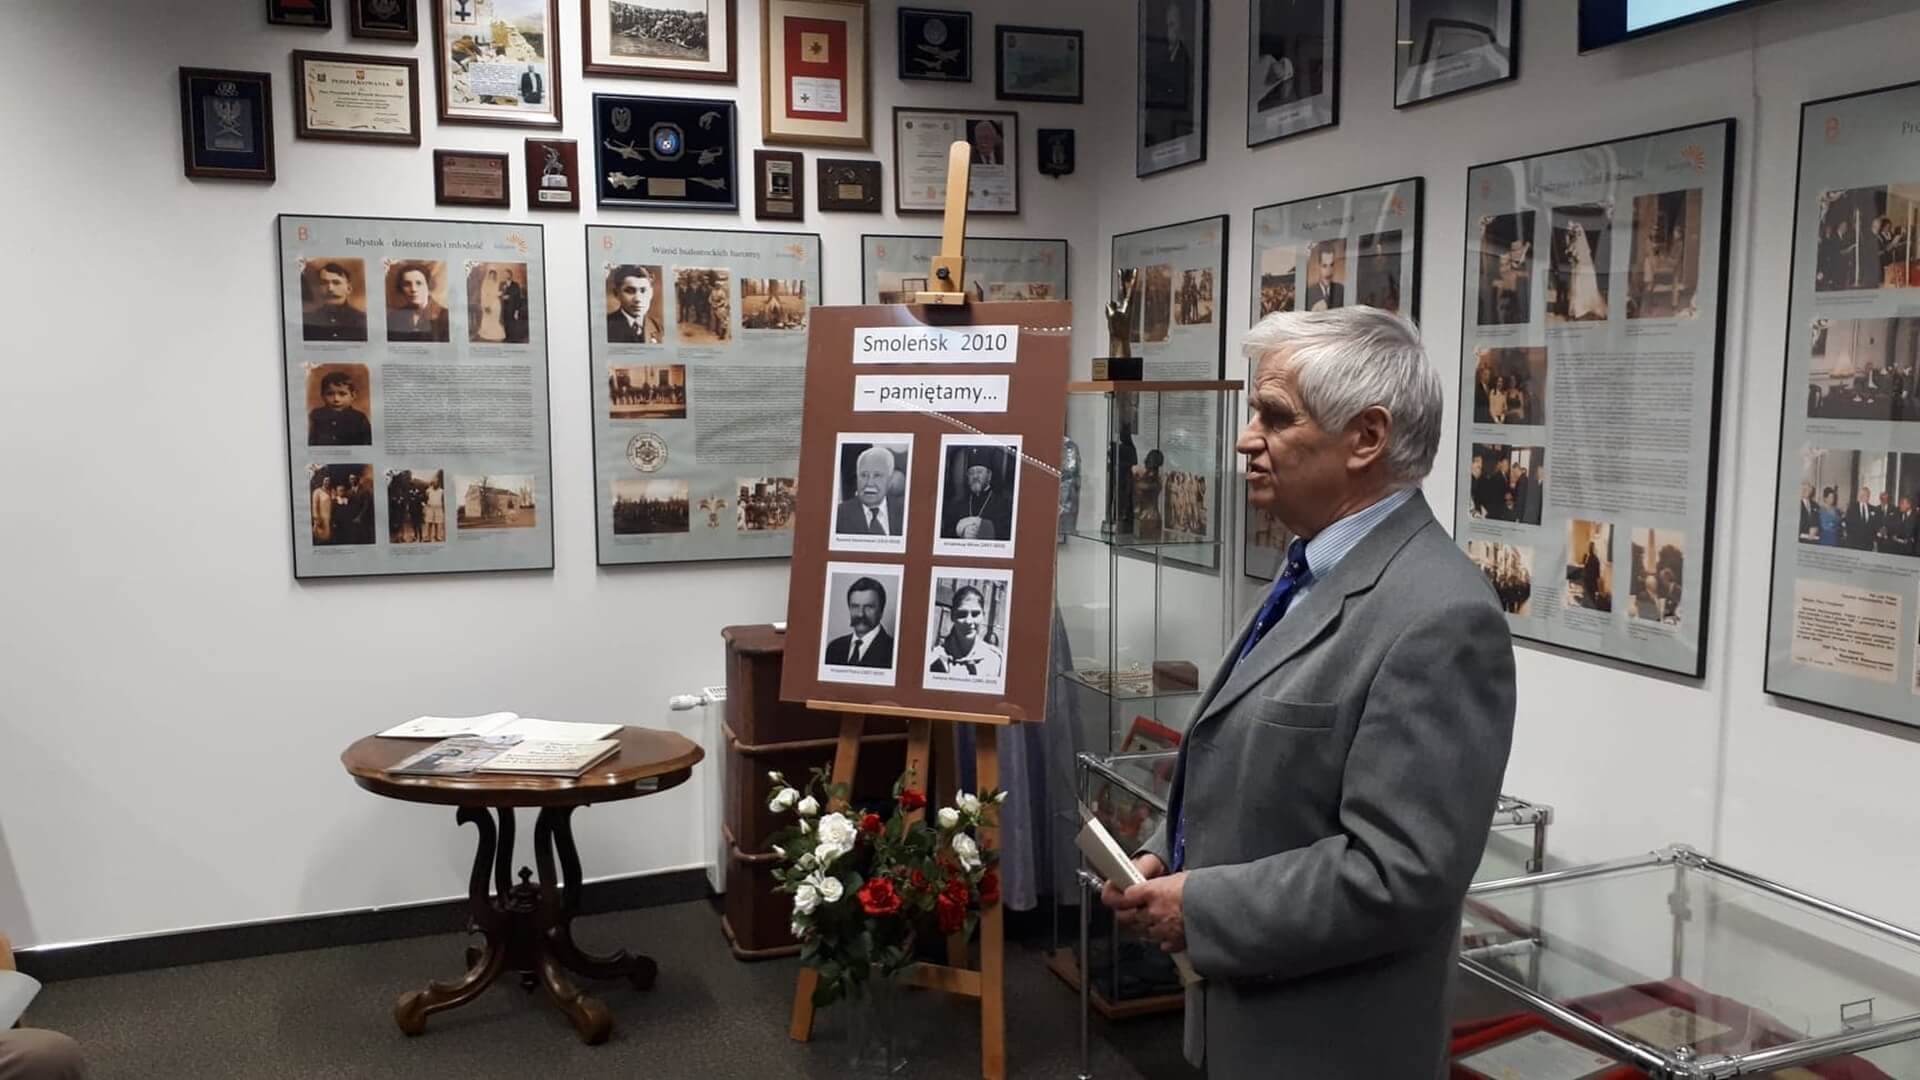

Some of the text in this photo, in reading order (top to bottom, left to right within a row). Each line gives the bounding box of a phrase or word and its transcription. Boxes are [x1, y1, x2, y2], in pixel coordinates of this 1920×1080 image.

[345, 237, 384, 249] Białystok
[392, 238, 442, 249] dzieciństwo
[863, 333, 1008, 352] Smoleńsk 2010
[880, 383, 998, 404] pamiętamy...
